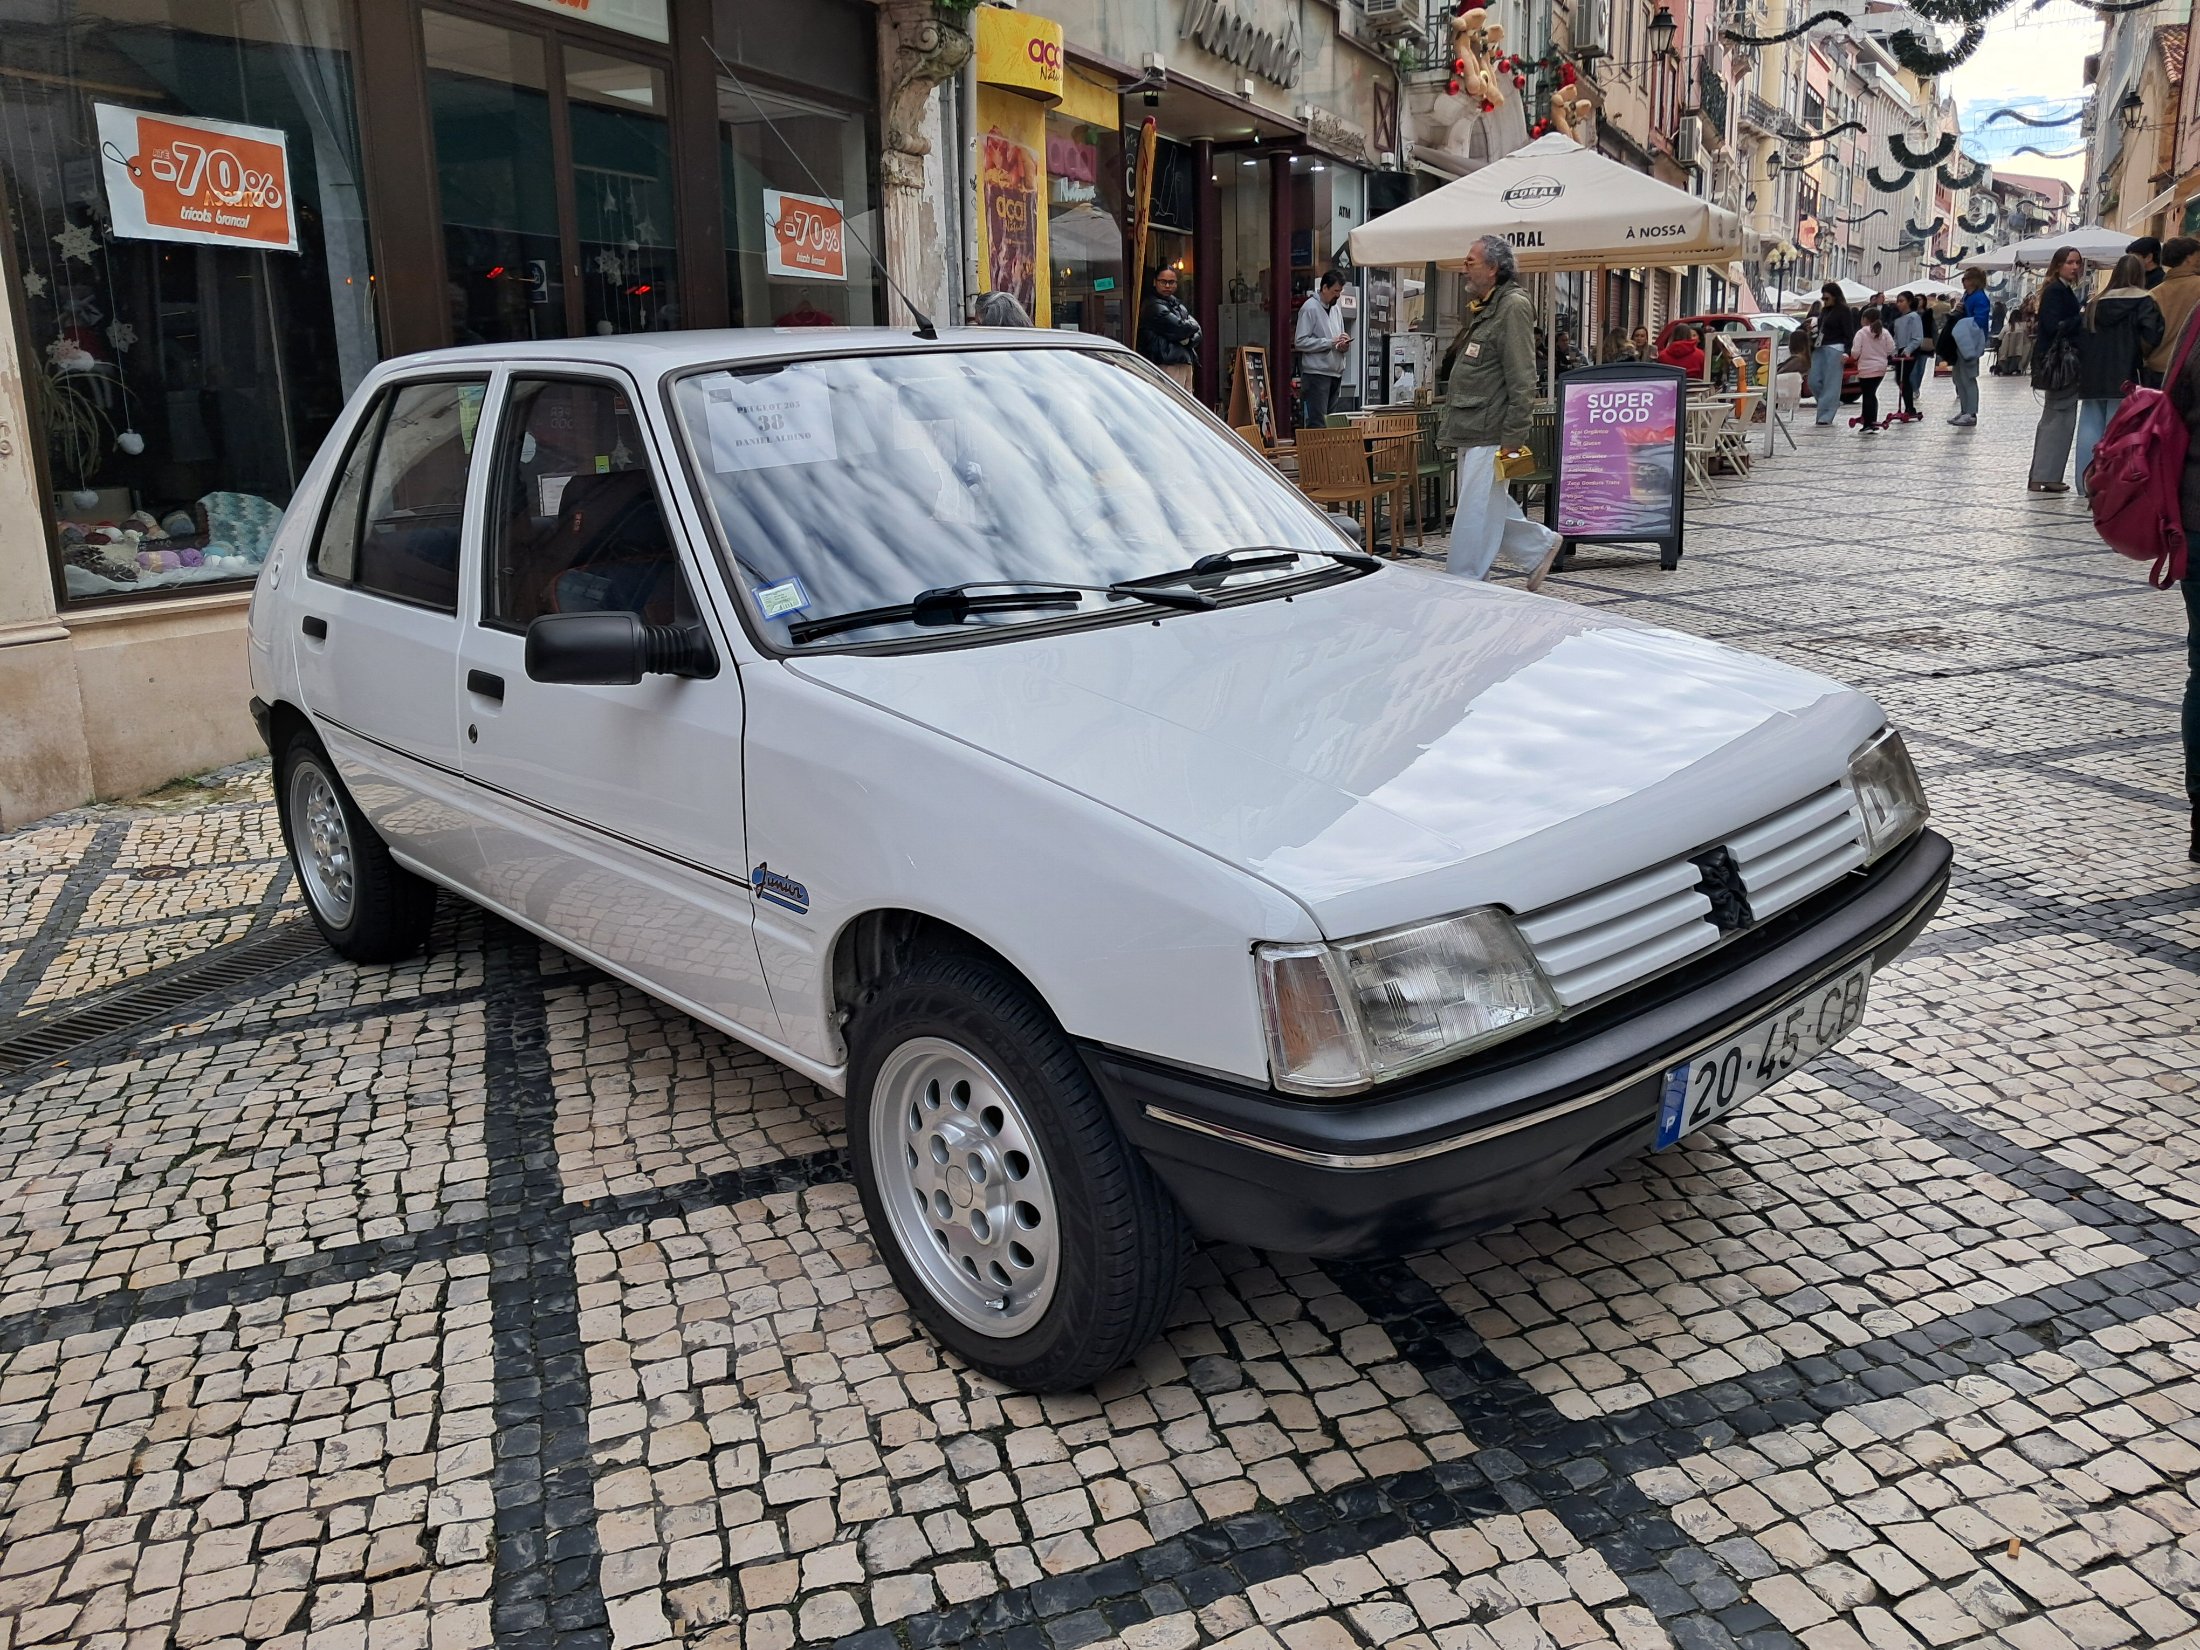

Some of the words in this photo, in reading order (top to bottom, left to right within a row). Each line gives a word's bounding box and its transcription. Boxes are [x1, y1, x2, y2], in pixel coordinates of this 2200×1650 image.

[151, 140, 282, 209] -70%
[1509, 187, 1558, 199] CORAL
[180, 205, 212, 224] tricots
[1338, 205, 1351, 219] ATM
[784, 210, 840, 253] -70%
[1499, 231, 1546, 248] ORAL
[1626, 225, 1636, 240] À
[1640, 224, 1687, 238] NOSSA
[1587, 392, 1654, 408] SUPER
[737, 403, 782, 414] PEUGEOT
[1590, 408, 1649, 424] FOOD
[758, 413, 785, 432] 38
[735, 437, 773, 447] DANIEL
